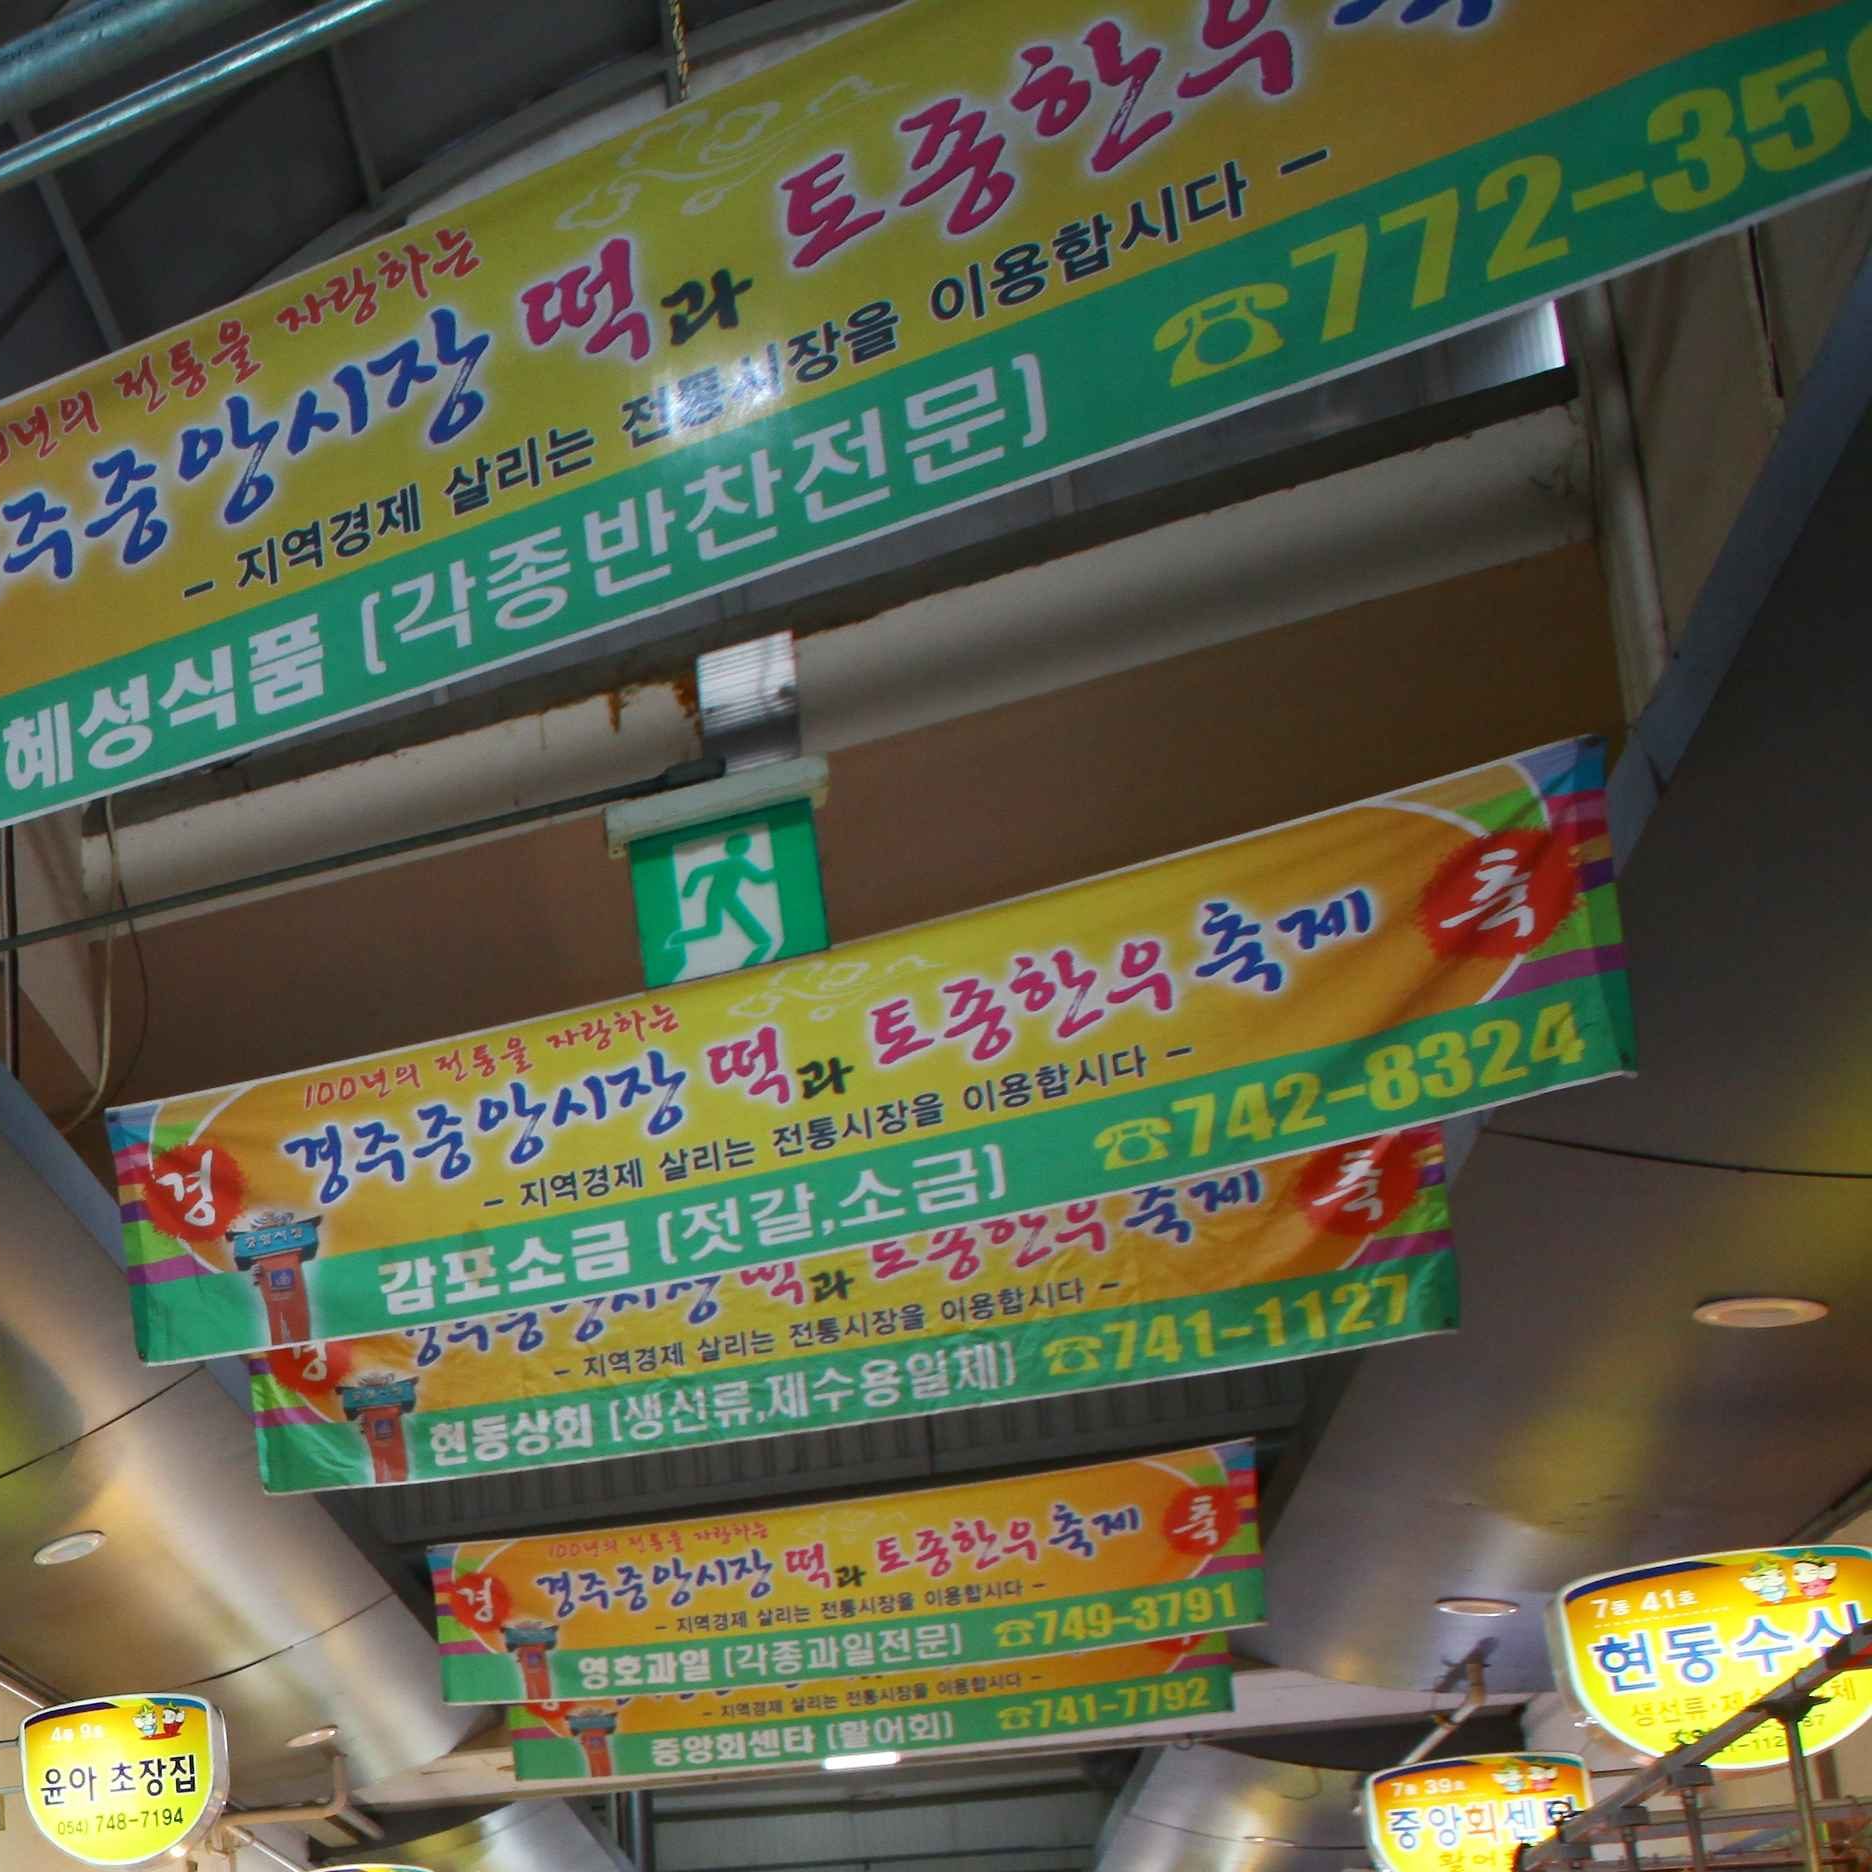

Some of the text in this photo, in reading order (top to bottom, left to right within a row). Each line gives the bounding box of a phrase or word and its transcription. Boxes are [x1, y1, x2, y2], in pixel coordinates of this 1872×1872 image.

[114, 318, 262, 414] 전통을
[276, 225, 482, 335] 자랑하는
[238, 159, 1247, 591] 지역경제 살리는 전통시장을 이용합시다
[3, 601, 325, 789] 혜성식품
[1440, 852, 1537, 941] 축
[284, 1051, 686, 1204] 경주중앙시장
[868, 939, 1173, 1066] 토종한우
[1194, 890, 1373, 991] 축제
[304, 1003, 680, 1107] 100년의 전통을 자랑하는
[378, 1221, 631, 1315] 감포소금
[1172, 1001, 1586, 1161] 742-8324
[519, 1046, 1147, 1208] 지역경제 살리는 전통시장을 이용합시다
[157, 1152, 216, 1227] 경
[428, 1406, 594, 1465] 현동상회
[1103, 1274, 1410, 1372] 741-1127
[583, 1344, 685, 1377] 지역경제
[697, 1330, 775, 1361] 살리는
[789, 1304, 926, 1347] 전통시장을
[941, 1282, 1084, 1321] 이용합시다
[459, 1578, 494, 1622] 경
[535, 1549, 774, 1618] 경주중앙시장
[876, 1519, 1039, 1578] 토종한우
[1049, 1505, 1142, 1557] 축제
[676, 1580, 1023, 1634] 지역경제 살리는 전통시장을 이용합시다
[1590, 1589, 1699, 1619] 7동 41호
[578, 1582, 1237, 1691] 영호과일 749-3791
[650, 1724, 816, 1766] 중앙회센타
[1033, 1677, 1211, 1728] 741-7792
[40, 1754, 197, 1806] 윤아 초장집
[96, 1807, 184, 1833] 748-7194
